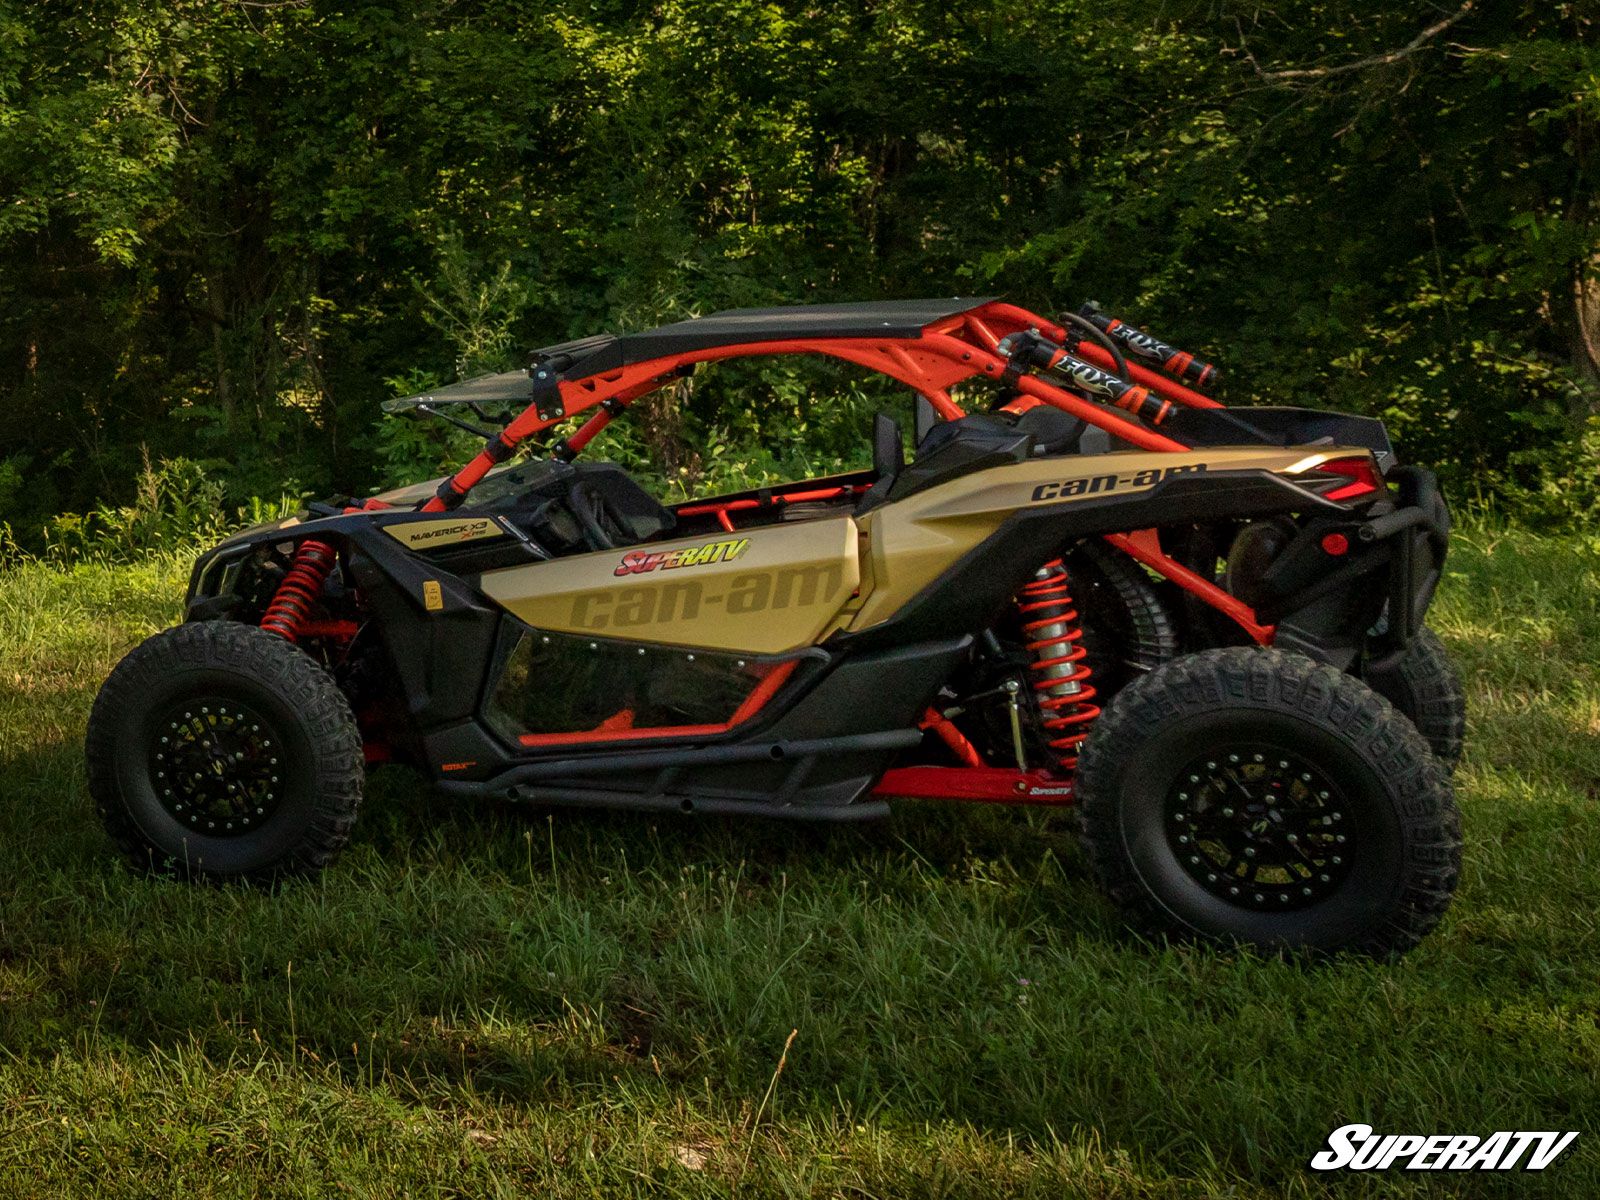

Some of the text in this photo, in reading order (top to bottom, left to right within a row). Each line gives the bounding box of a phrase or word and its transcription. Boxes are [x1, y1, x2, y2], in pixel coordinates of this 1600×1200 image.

[1111, 323, 1171, 361] FOX
[1054, 356, 1121, 398] FOX
[411, 522, 487, 541] MAVERICK X3
[614, 538, 749, 576] SUPERATV
[570, 563, 842, 628] can-am
